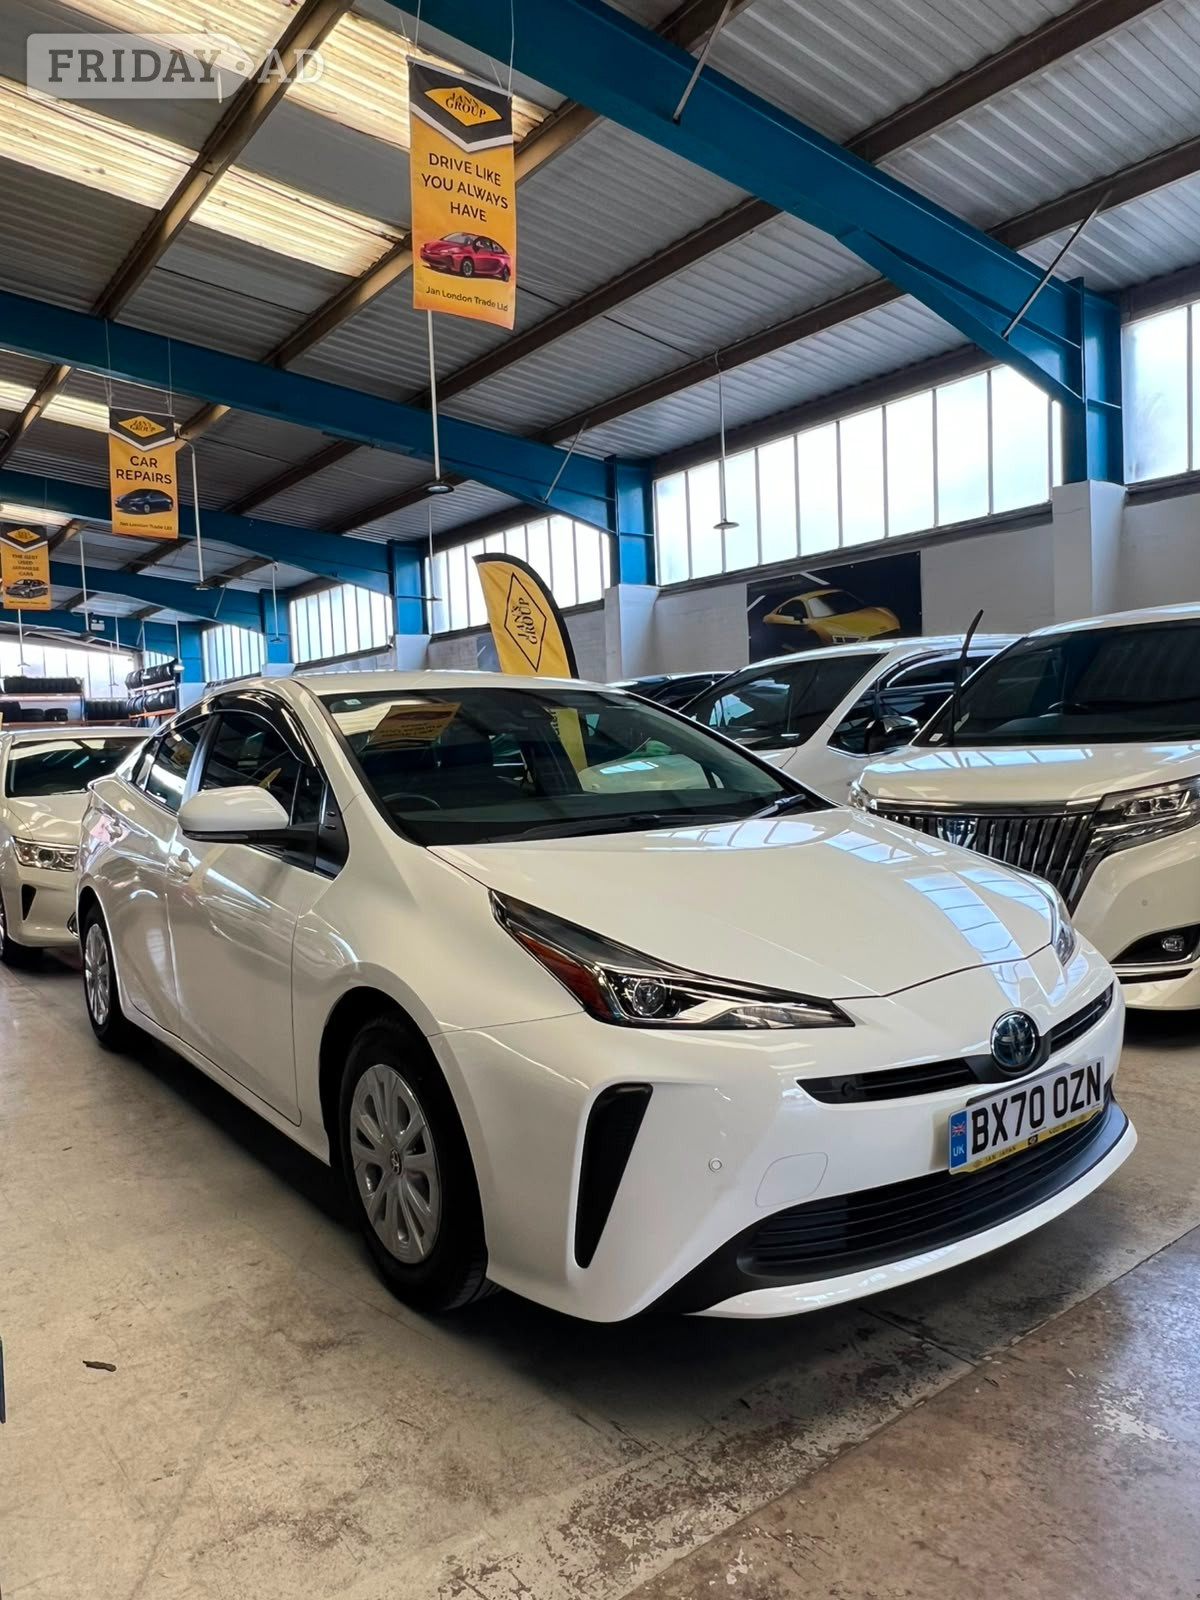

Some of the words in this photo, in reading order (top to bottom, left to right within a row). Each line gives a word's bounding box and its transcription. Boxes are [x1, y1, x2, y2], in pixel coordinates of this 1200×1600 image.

[445, 97, 487, 118] GROUP
[429, 152, 473, 175] DRIVE
[475, 164, 502, 187] LIKE
[421, 172, 454, 191] YOU
[457, 181, 509, 209] ALWAYS
[450, 201, 487, 222] HAVE
[425, 286, 441, 296] Jan
[442, 289, 473, 303] London
[474, 296, 496, 308] Trade
[129, 455, 158, 469] CAR
[115, 468, 172, 485] REPAIRS
[518, 597, 538, 645] GROUP
[971, 1085, 1045, 1155] BX70
[1053, 1062, 1101, 1119] OZN
[953, 1143, 965, 1157] UK
